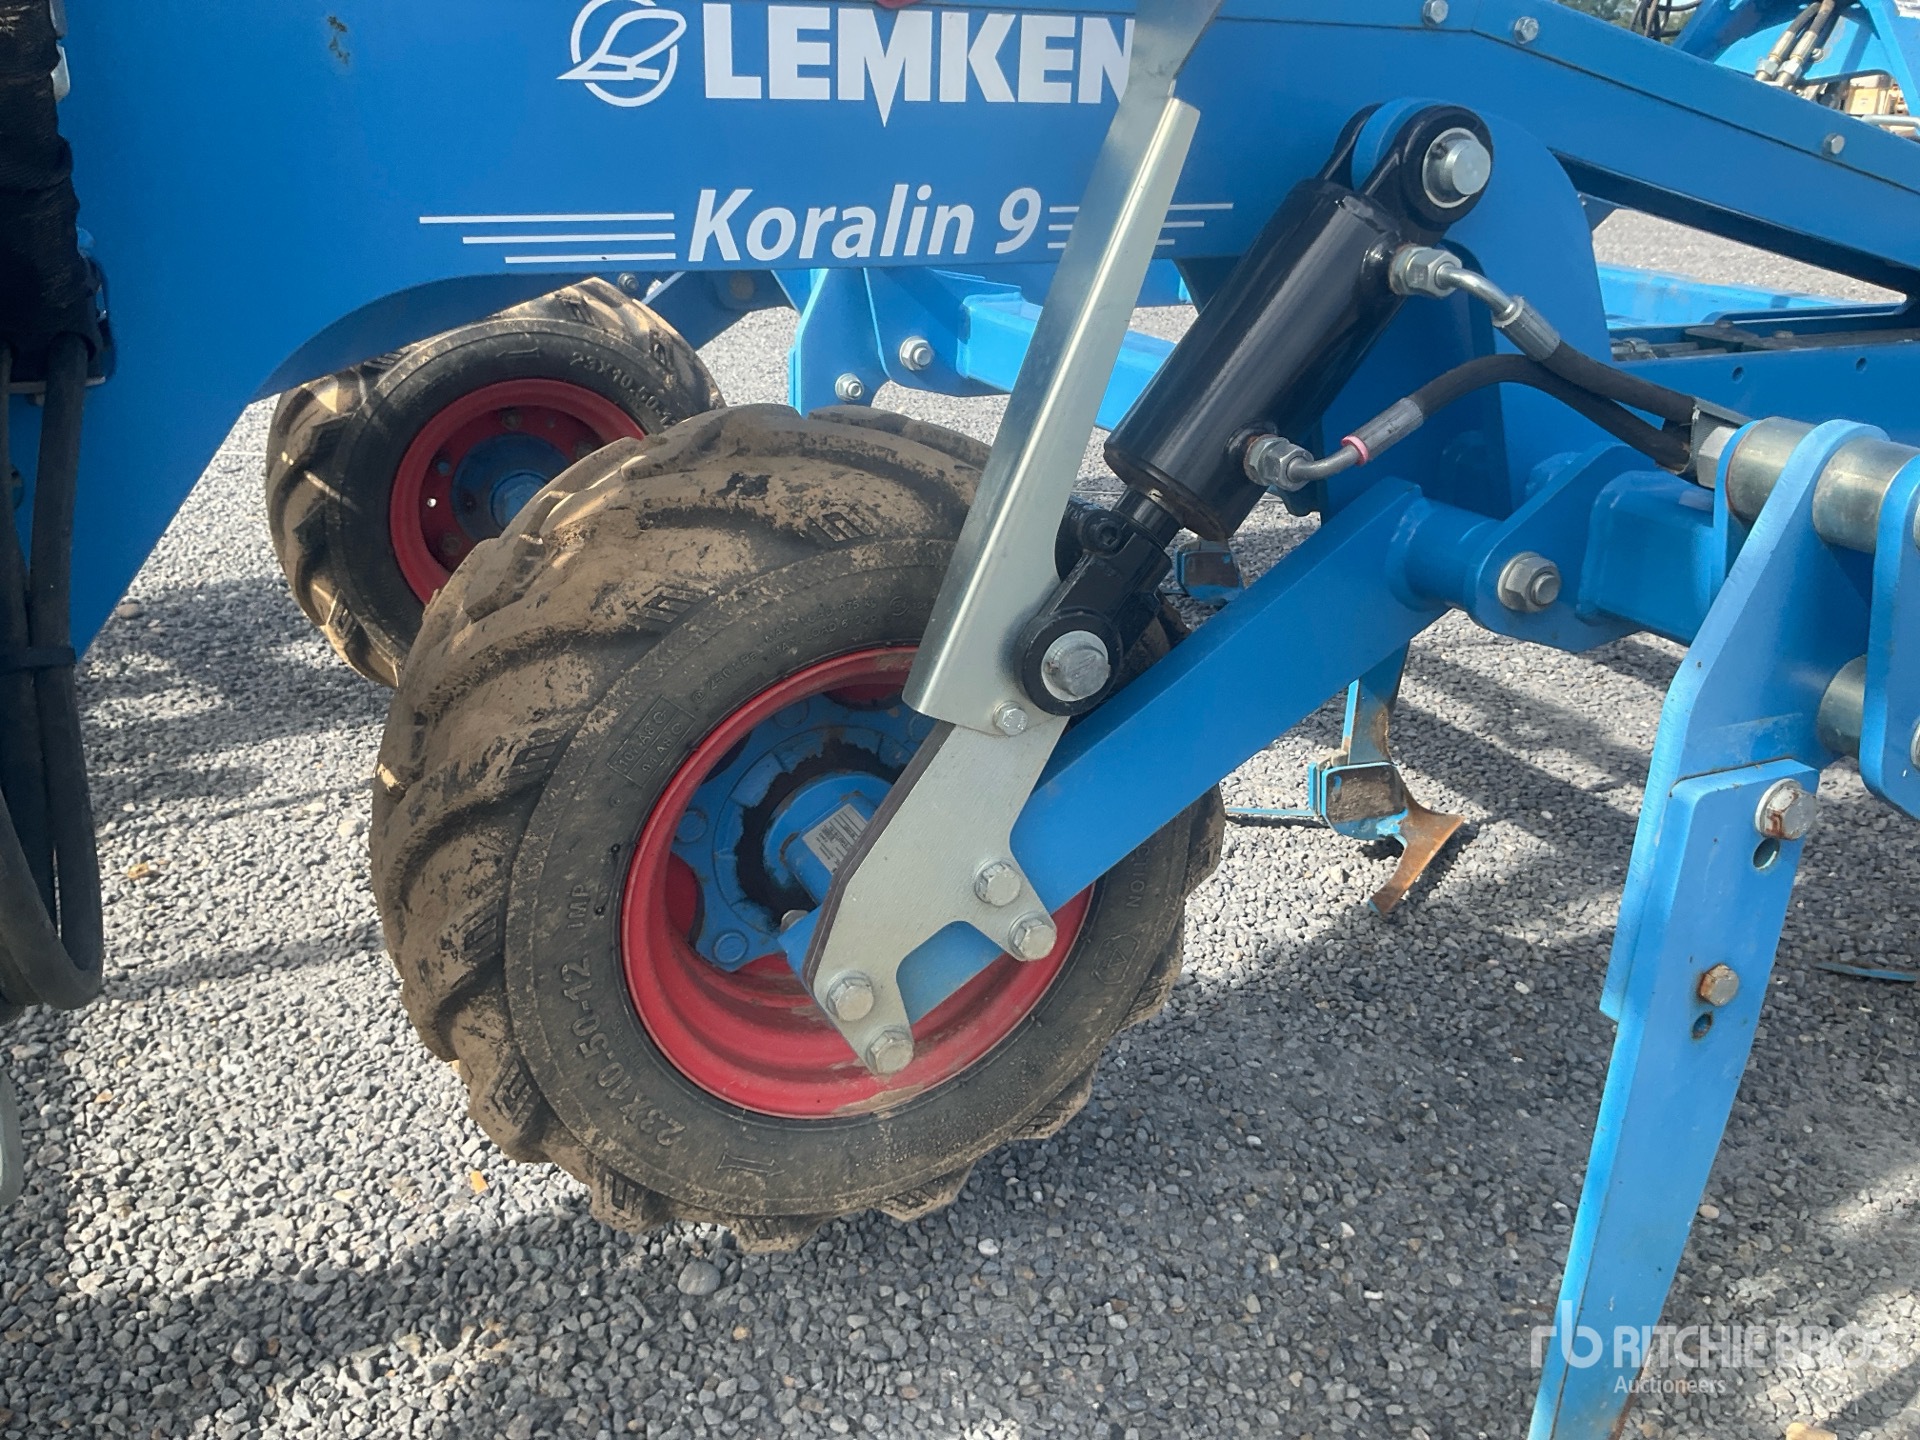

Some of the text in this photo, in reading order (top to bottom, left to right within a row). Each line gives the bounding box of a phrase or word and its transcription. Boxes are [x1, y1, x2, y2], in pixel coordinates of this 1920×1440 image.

[703, 3, 1135, 127] LEMKEN
[688, 184, 1042, 262] Koralin 9
